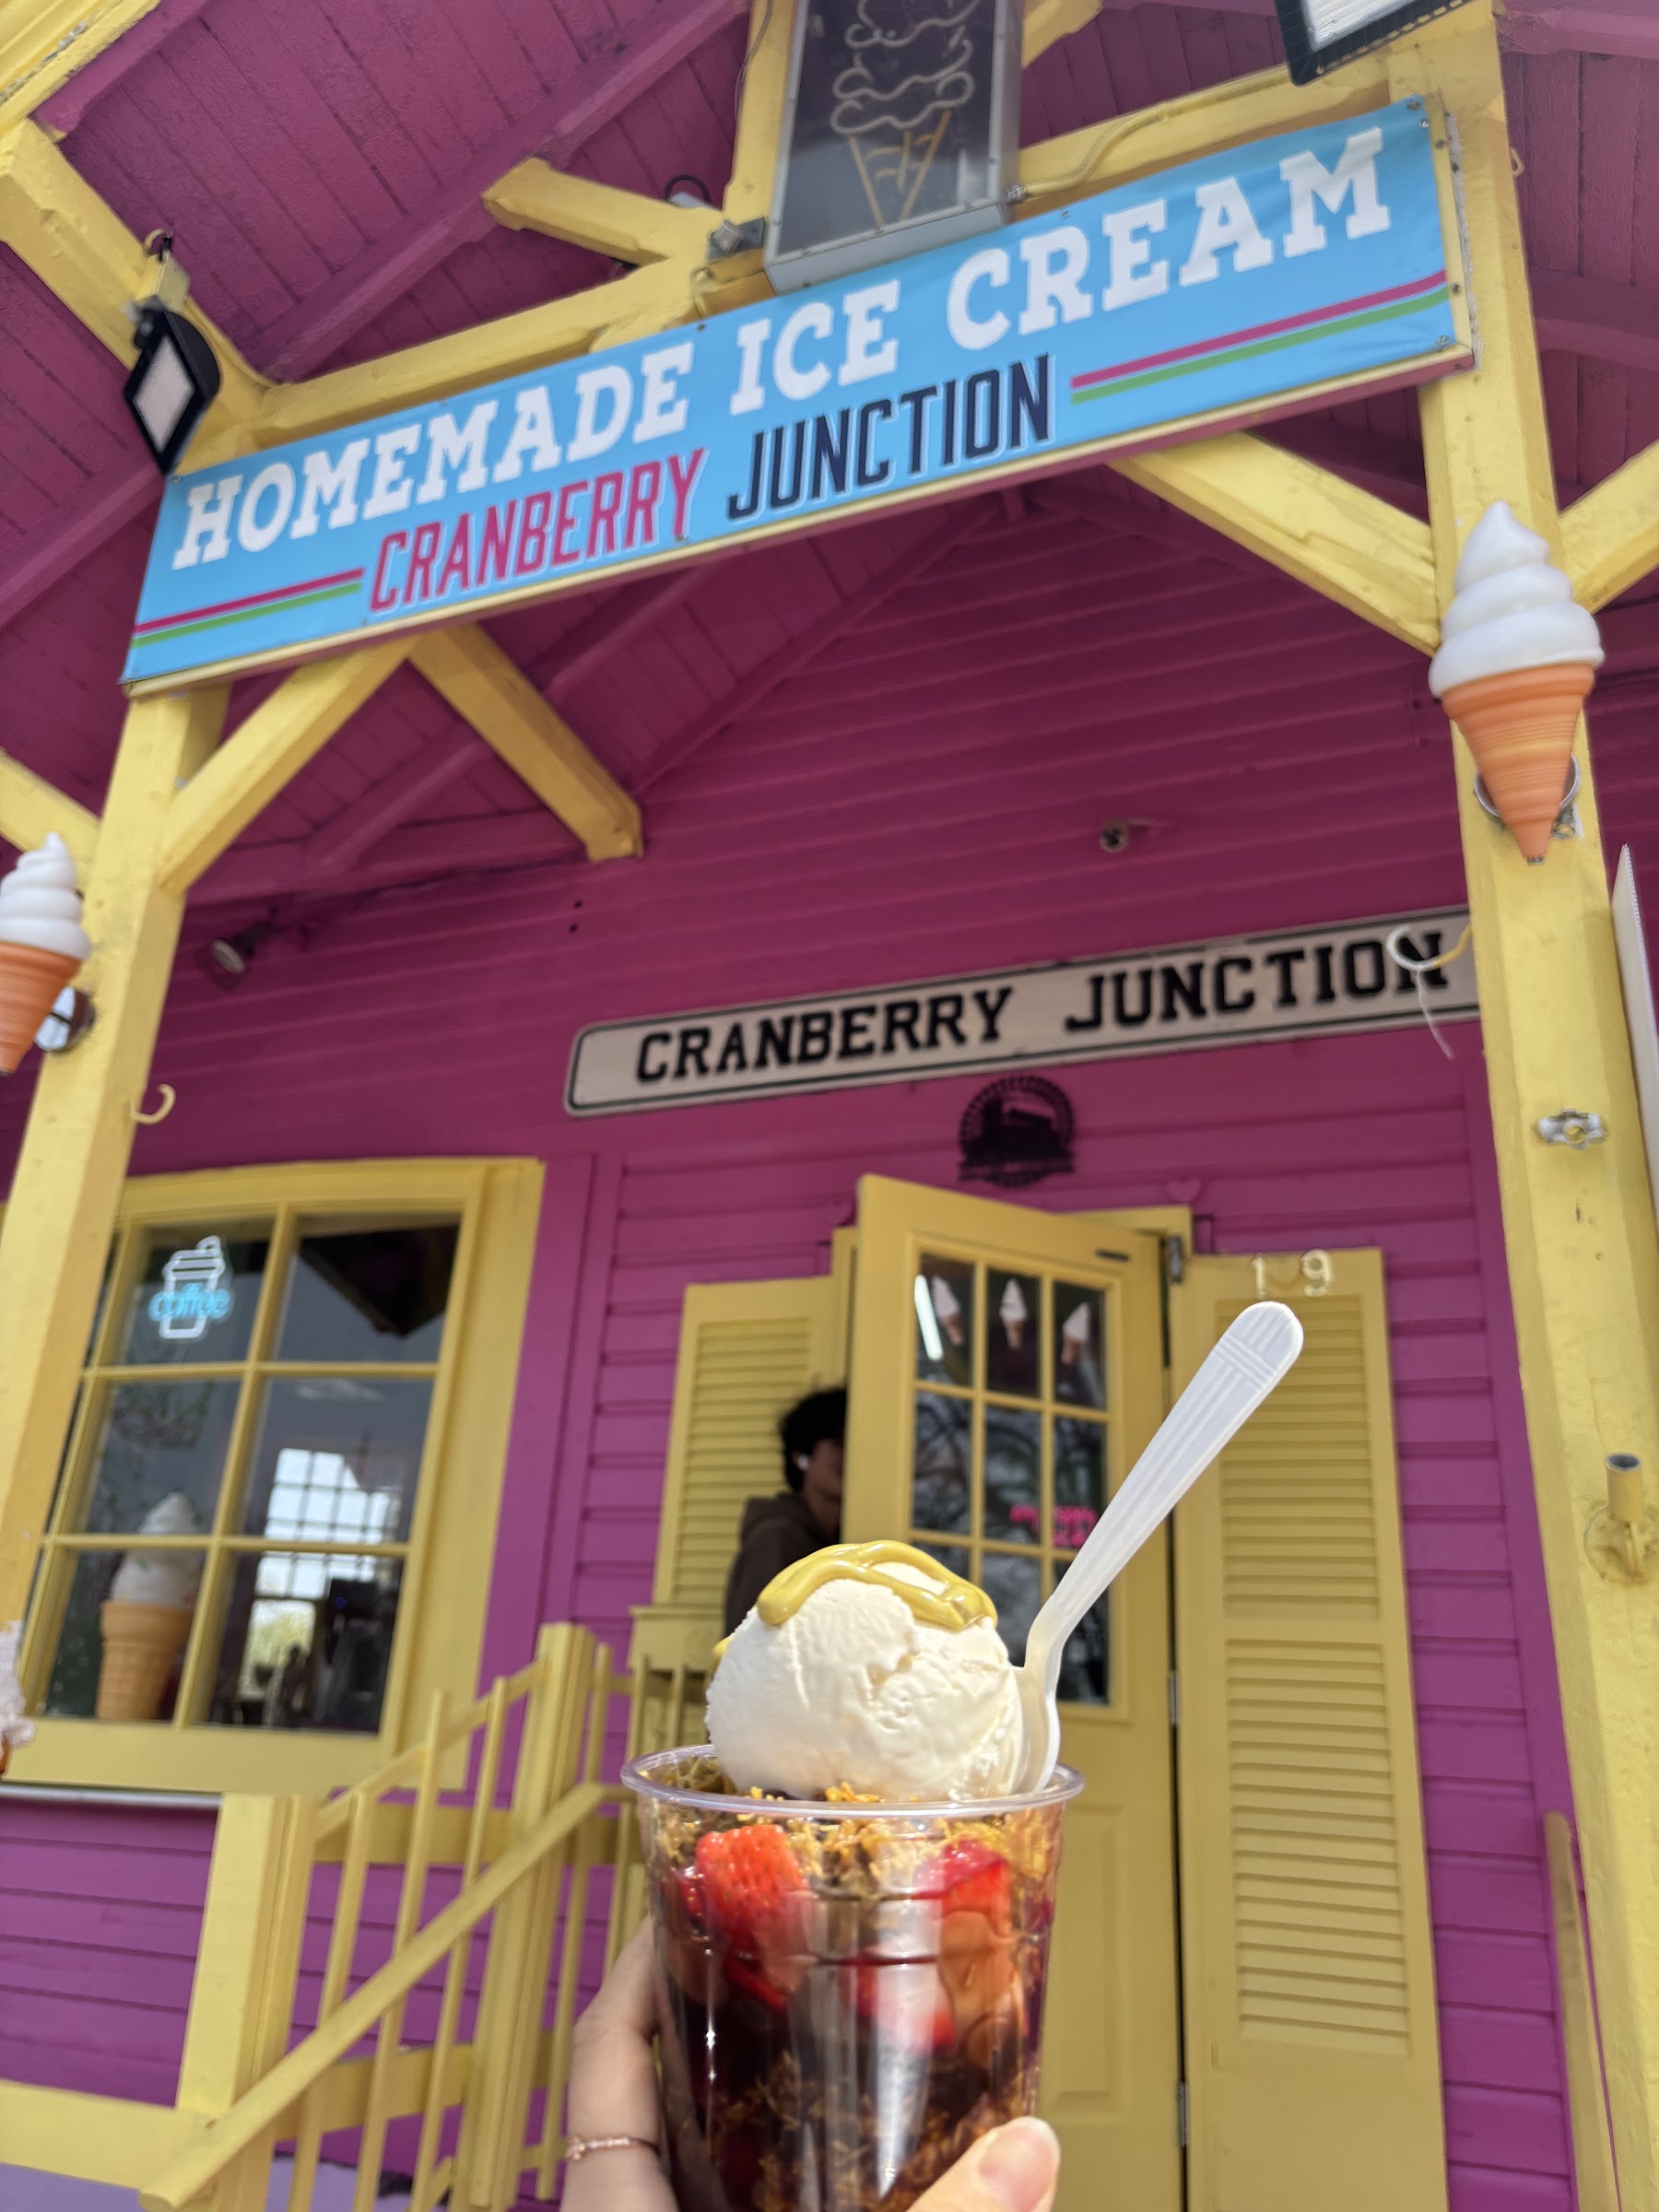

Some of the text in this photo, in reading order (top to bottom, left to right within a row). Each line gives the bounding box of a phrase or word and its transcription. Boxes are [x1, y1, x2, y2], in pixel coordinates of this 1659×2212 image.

[171, 127, 1392, 571] HOMEMADE ICE CREAM
[370, 353, 1053, 614] CRANBERRY JUNCTION
[634, 930, 1448, 1085] CRANBERRY JUNCTION
